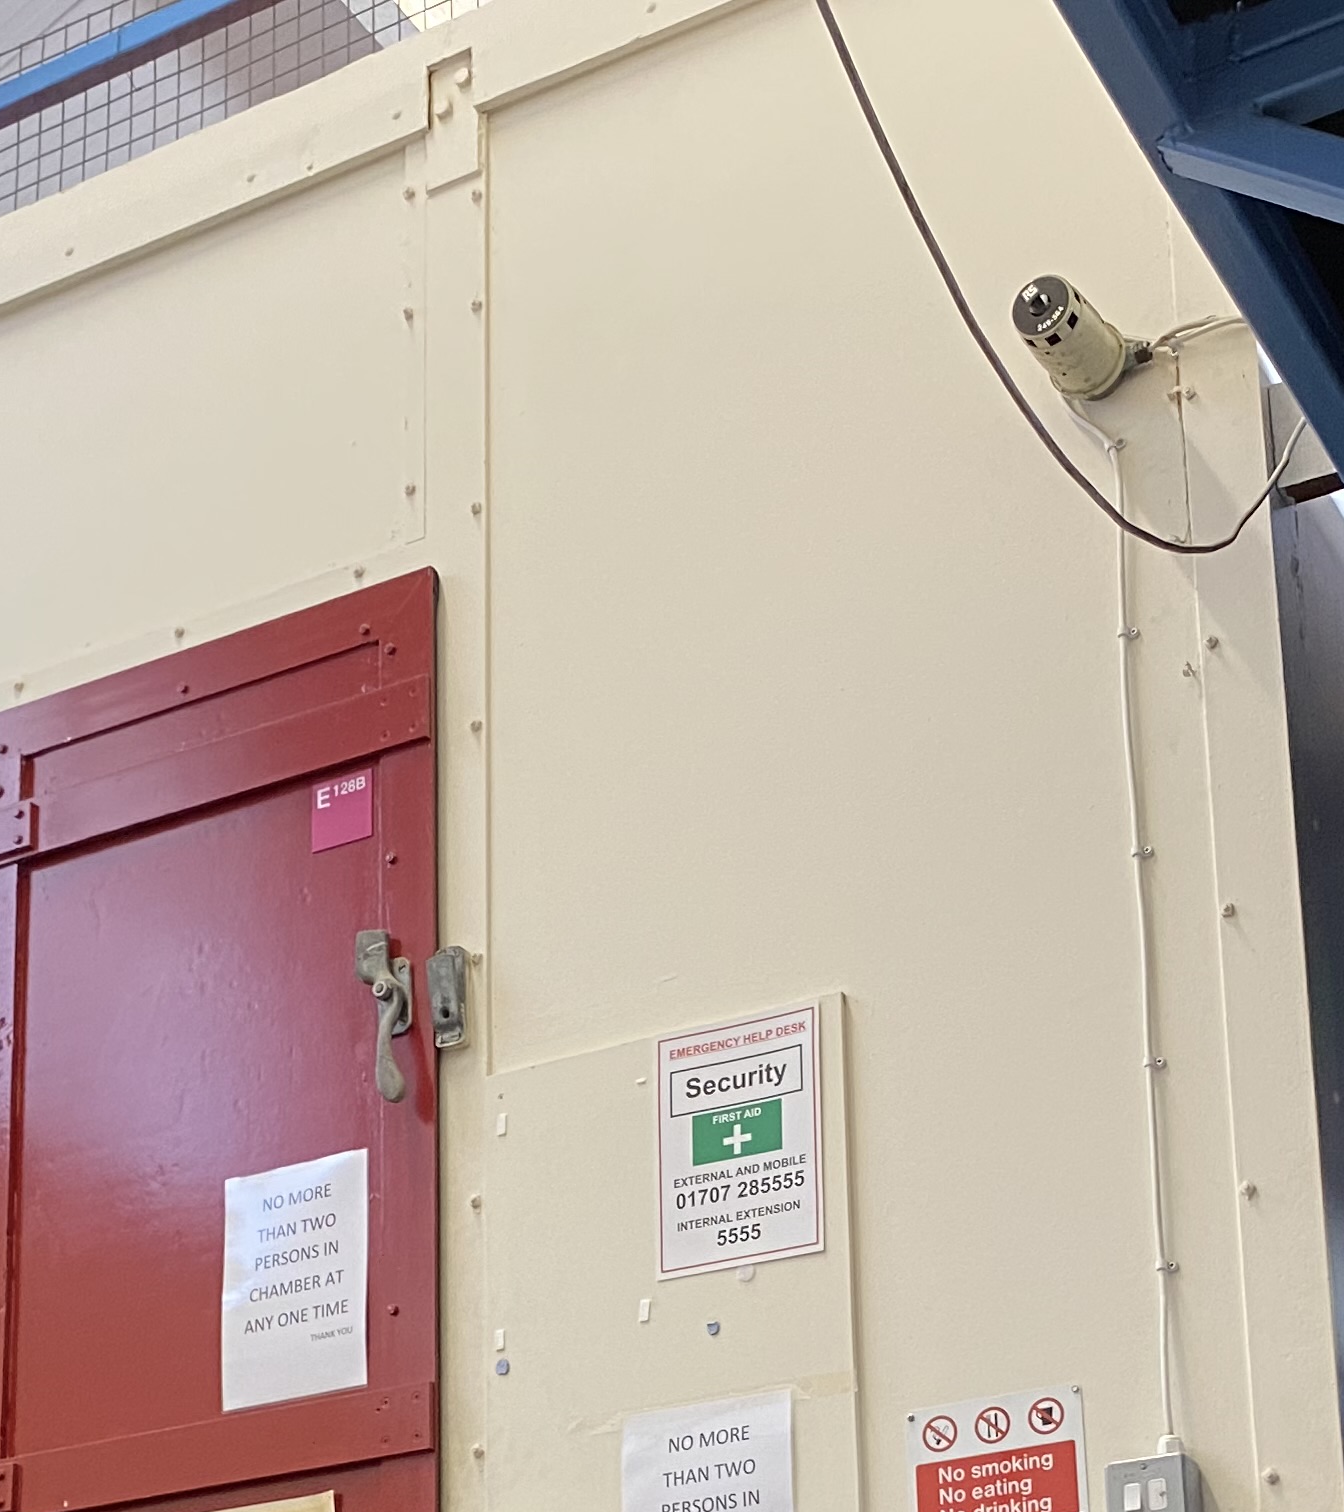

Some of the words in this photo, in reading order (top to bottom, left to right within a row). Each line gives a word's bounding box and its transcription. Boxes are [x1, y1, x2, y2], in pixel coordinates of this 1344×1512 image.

[1021, 284, 1038, 302] RS
[670, 1037, 741, 1060] EMERGENCY
[743, 1029, 773, 1044] HELP
[776, 1021, 806, 1036] DESK
[686, 1063, 787, 1098] Security
[712, 1111, 742, 1124] FIRST
[744, 1107, 761, 1118] AID
[674, 1170, 733, 1188] EXTERNAL
[736, 1164, 760, 1177] AND
[763, 1154, 806, 1171] MOBILE
[263, 1195, 284, 1212] NO
[288, 1183, 332, 1205] MORE
[676, 1185, 730, 1209] 01707
[737, 1170, 804, 1198] 285555
[257, 1221, 296, 1243] THAN
[301, 1213, 336, 1233] TWO
[677, 1213, 733, 1232] INTERNAL
[736, 1200, 801, 1221] EXTENSION
[717, 1223, 761, 1246] 5555
[255, 1244, 319, 1271] PERSONS
[323, 1240, 338, 1256] IN
[250, 1274, 321, 1302] CHAMBER
[325, 1270, 344, 1287] AT
[244, 1315, 274, 1335] ANY
[277, 1308, 308, 1327] ONE
[313, 1299, 349, 1319] TIME
[310, 1331, 335, 1342] THANK
[337, 1326, 353, 1335] YOU
[668, 1435, 693, 1453] NO
[699, 1425, 750, 1448] MORE
[663, 1466, 709, 1487] THAN
[714, 1459, 756, 1479] TWO
[938, 1466, 965, 1484] No
[971, 1453, 1053, 1479] smoking
[743, 1489, 760, 1506] IN
[939, 1487, 966, 1505] No
[972, 1478, 1032, 1500] eating
